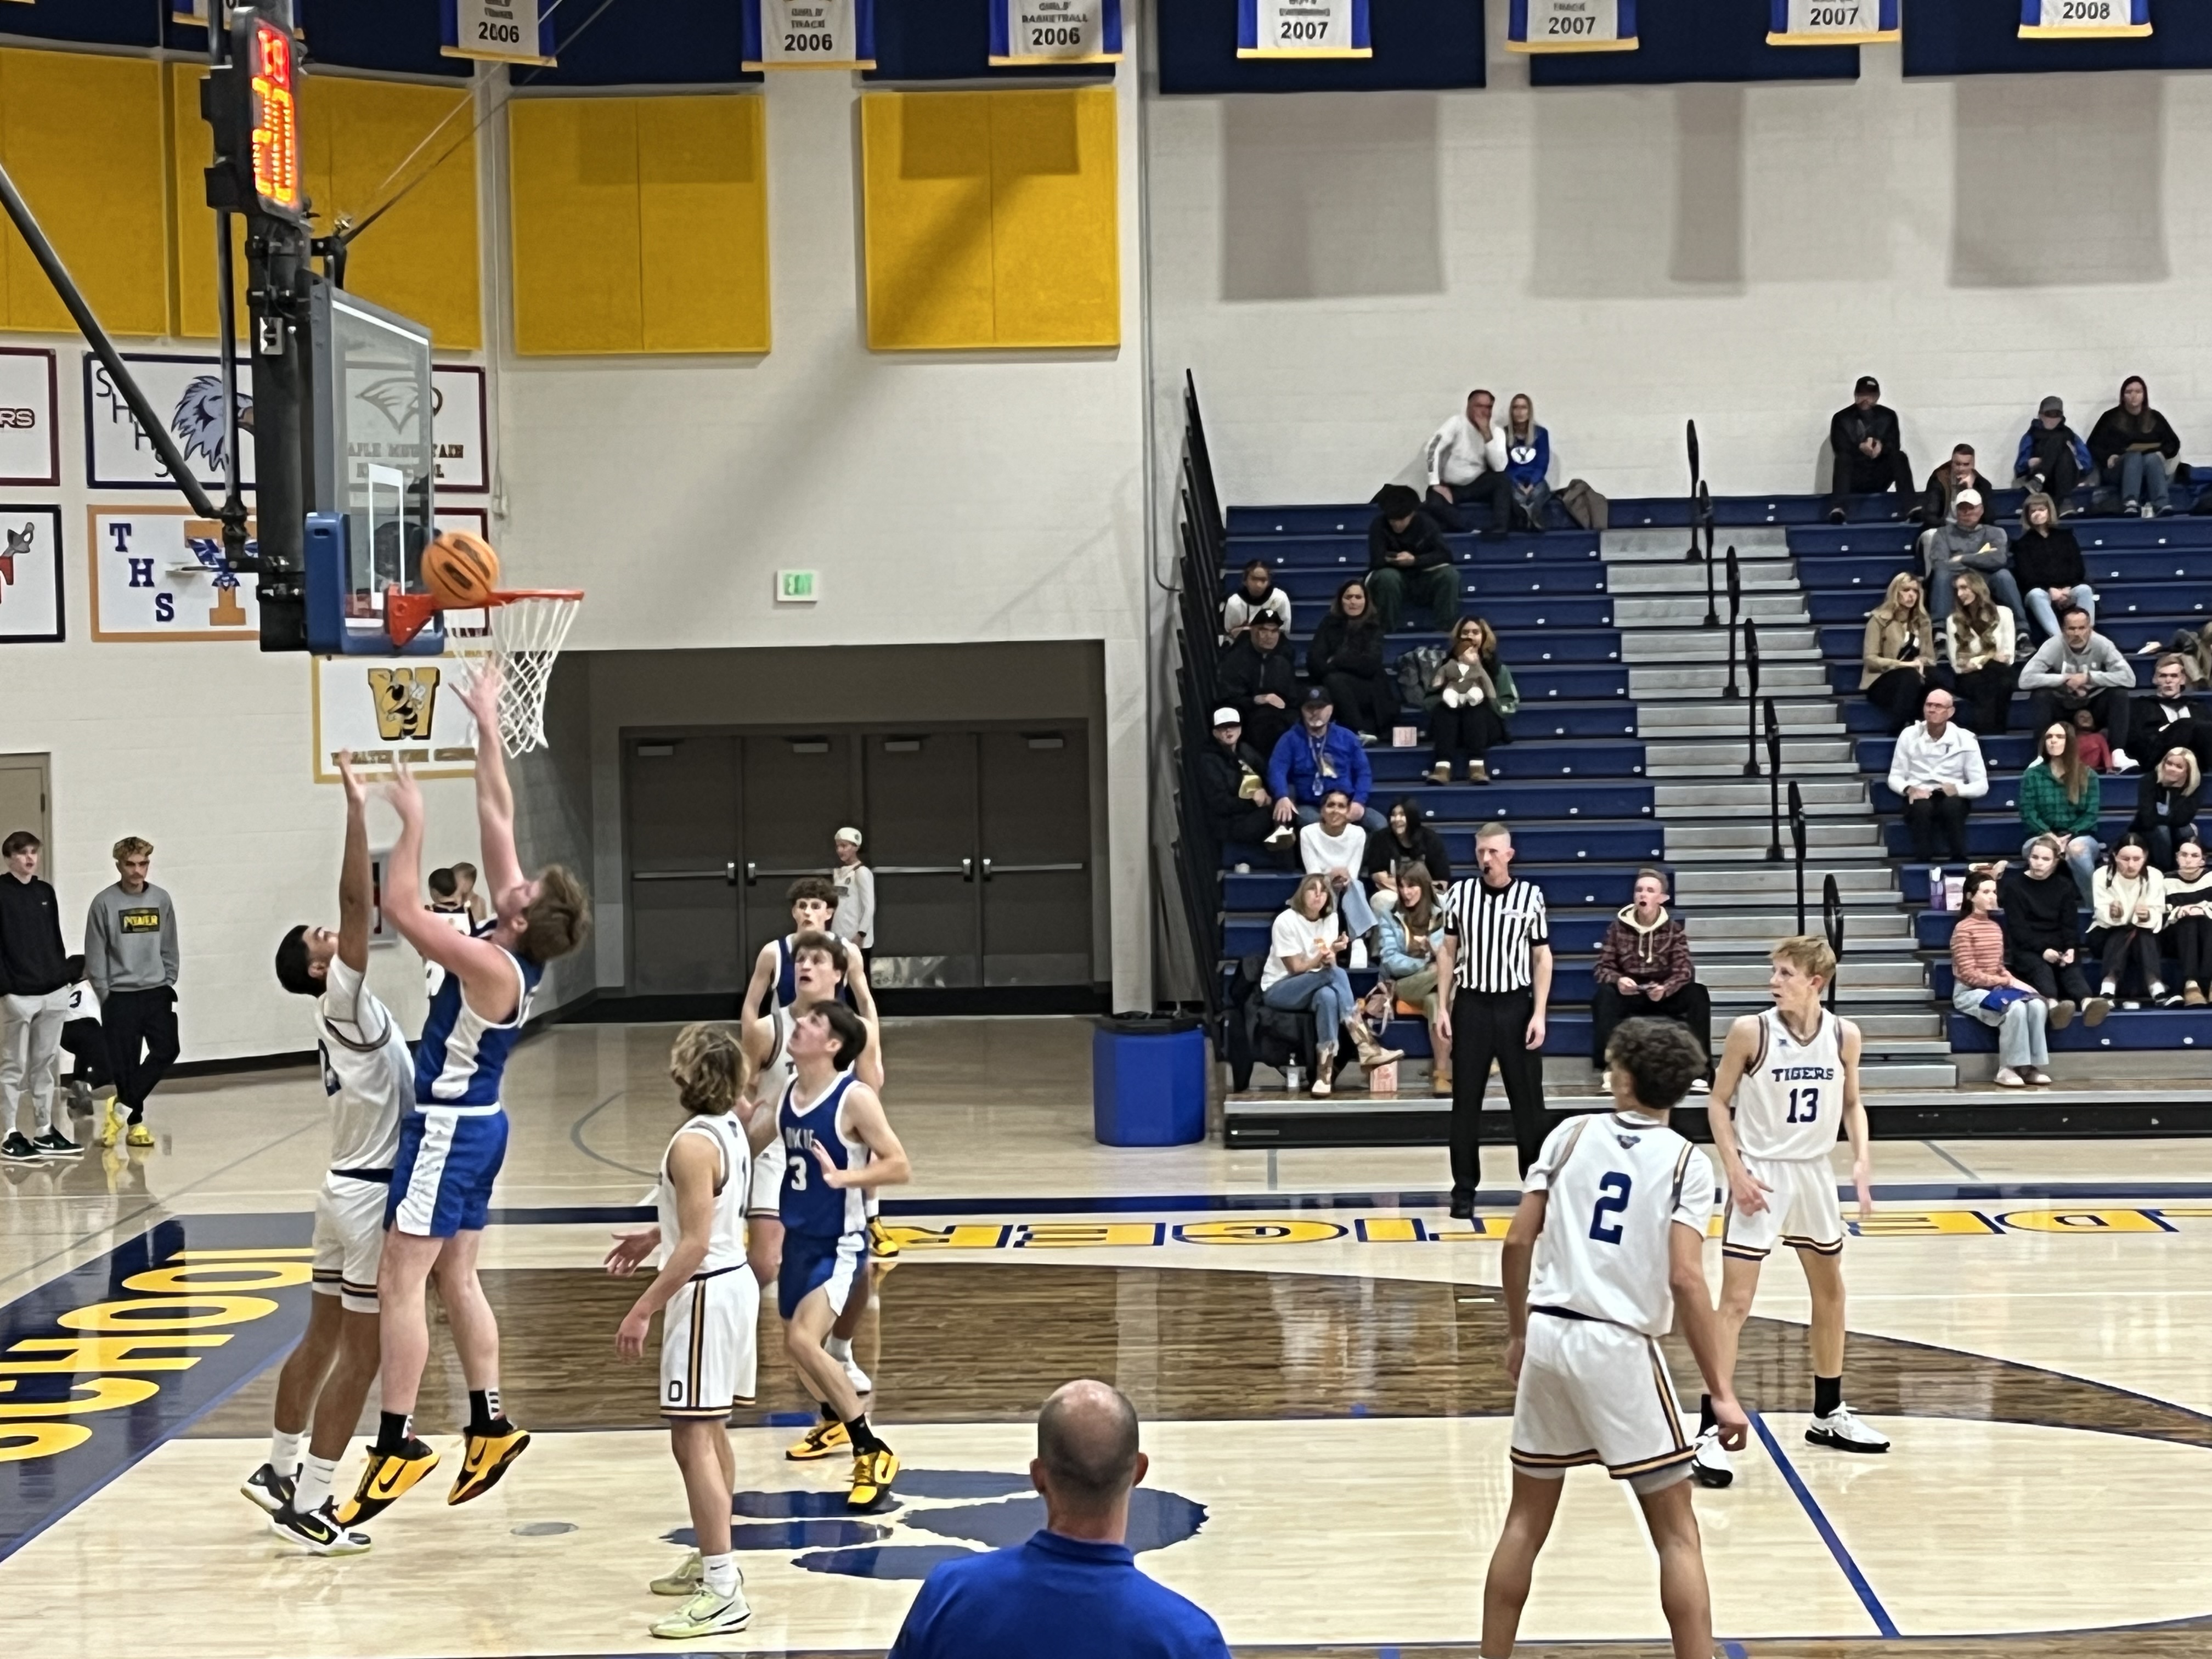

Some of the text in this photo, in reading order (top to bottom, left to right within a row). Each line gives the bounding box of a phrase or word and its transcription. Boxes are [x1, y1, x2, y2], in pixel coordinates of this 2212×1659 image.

[1810, 7, 1859, 25] 2007
[2063, 2, 2110, 19] 2008
[478, 21, 519, 43] 2006
[1281, 21, 1328, 40] 2007
[1549, 16, 1596, 34] 2007
[785, 34, 833, 51] 2006
[1032, 27, 1080, 46] 2006
[1786, 1087, 1819, 1124] 13
[789, 1155, 807, 1191] 3
[1589, 1171, 1632, 1245] 2
